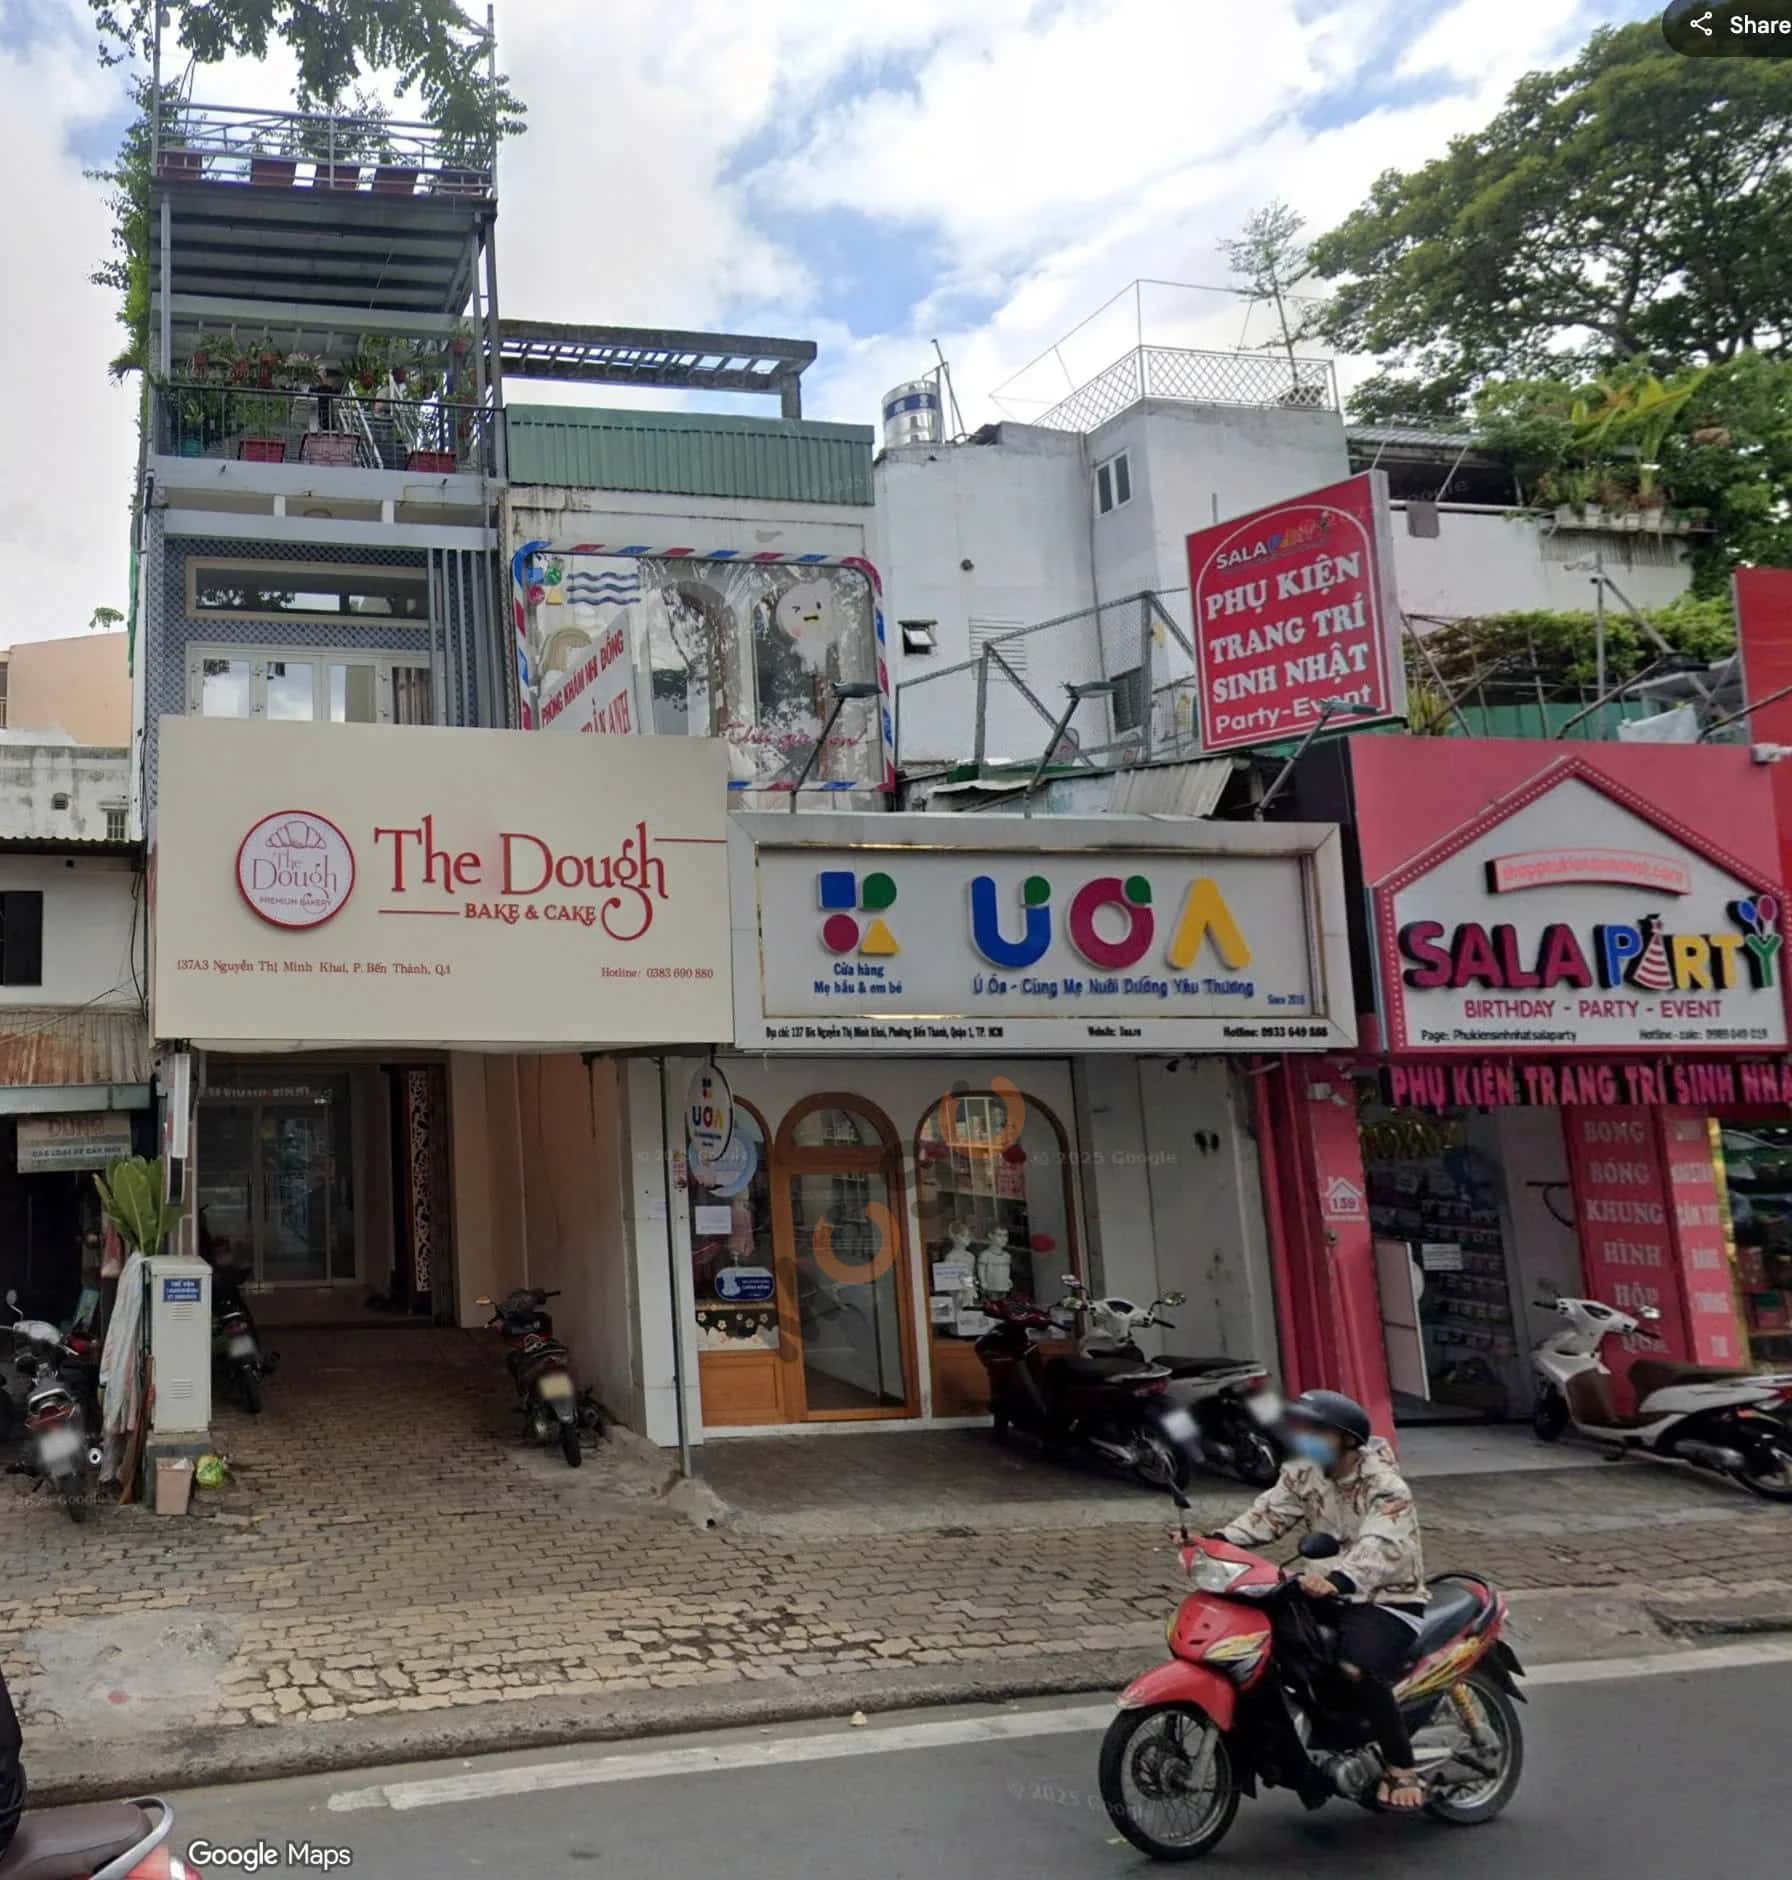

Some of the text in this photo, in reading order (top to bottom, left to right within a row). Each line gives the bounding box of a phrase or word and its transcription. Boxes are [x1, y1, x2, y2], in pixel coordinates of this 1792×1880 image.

[1216, 541, 1267, 570] SALA
[1206, 553, 1361, 620] PHỤ KIỆN
[1210, 592, 1367, 664] TRANG TRÍ
[1213, 642, 1369, 704] SINH NHẬT
[251, 854, 338, 914] Dough
[374, 814, 669, 941] The Dough
[465, 902, 597, 926] BAKE & CAKE
[283, 961, 313, 973] Minh
[1400, 919, 1593, 990] SALA
[857, 963, 885, 978] hàng
[814, 980, 830, 996] Mẹ
[858, 981, 867, 994] &
[870, 984, 886, 994] em
[1465, 1000, 1555, 1018] BIRTHDAY
[1579, 1000, 1639, 1018] PARTY
[1661, 1000, 1722, 1018] EVENT
[1421, 1029, 1450, 1043] Page:
[1390, 1065, 1447, 1116] PHỤ
[1453, 1058, 1515, 1113] KIỆN
[1523, 1064, 1617, 1105] TRANG
[1624, 1058, 1668, 1105] TRÍ
[1673, 1063, 1736, 1105] SINH
[1586, 1200, 1664, 1224] KHUNG
[1603, 1238, 1661, 1266] HÌNH
